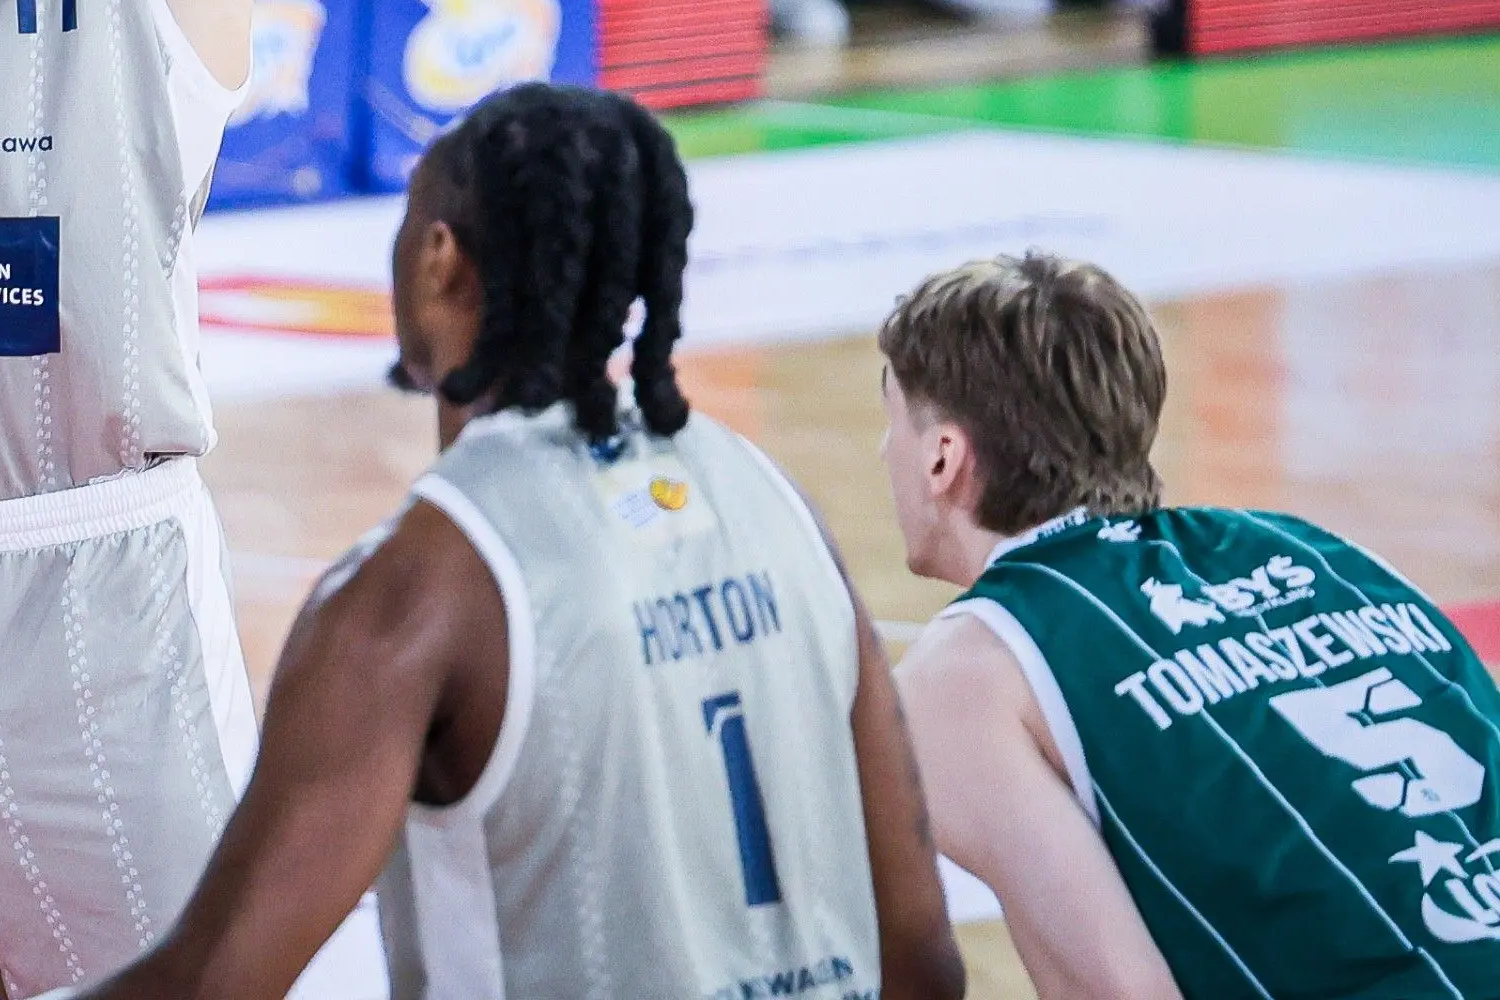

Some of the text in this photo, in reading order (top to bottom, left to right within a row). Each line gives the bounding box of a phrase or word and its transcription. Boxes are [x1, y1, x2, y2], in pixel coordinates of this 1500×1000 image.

[632, 569, 784, 666] HORTON
[1114, 602, 1453, 731] TOMASZEWSKI
[701, 692, 785, 907] 1
[1268, 666, 1486, 819] 5
